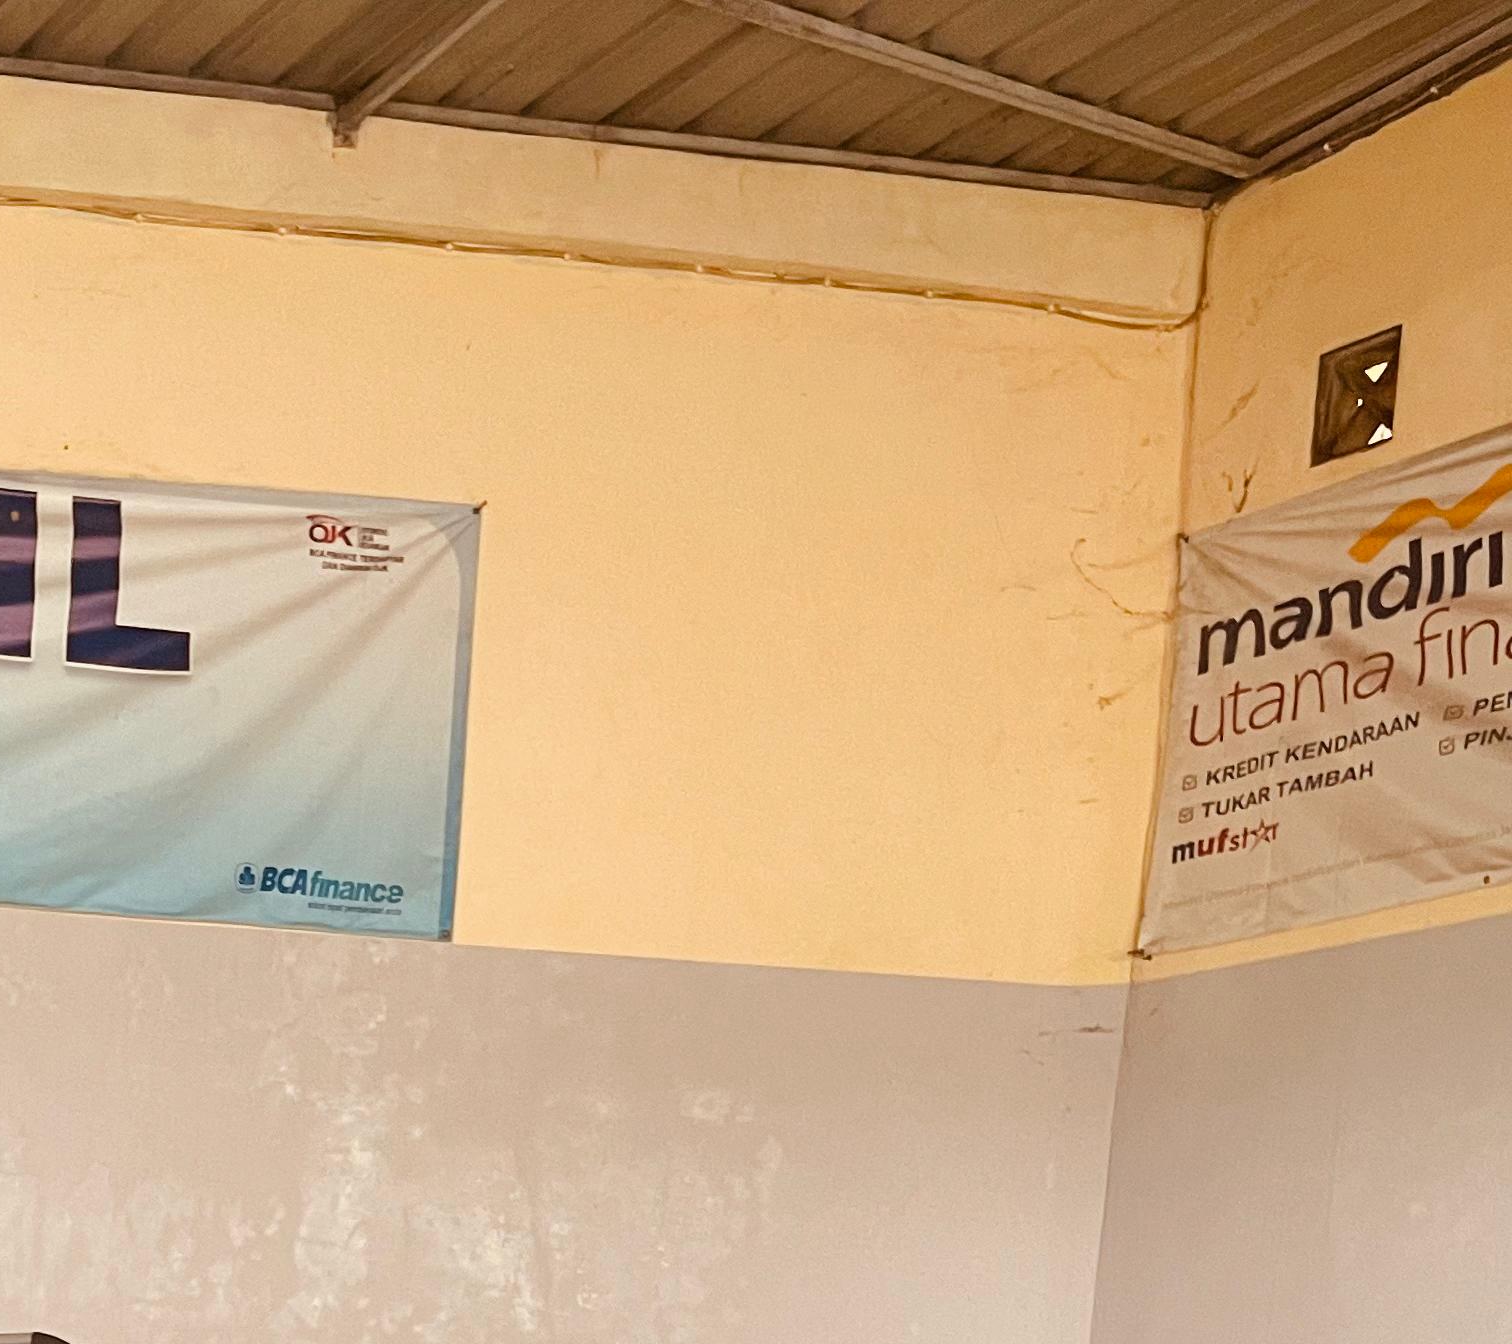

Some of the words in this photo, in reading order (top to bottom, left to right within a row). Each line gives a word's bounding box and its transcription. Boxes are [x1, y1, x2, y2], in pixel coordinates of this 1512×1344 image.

[1196, 530, 1504, 676] mandiri
[1188, 650, 1394, 748] utama
[1413, 606, 1512, 686] fin
[1205, 750, 1278, 786] KREDIT
[1284, 711, 1420, 764] KENDARAAN
[1464, 727, 1512, 749] PIN
[1201, 785, 1271, 818] TUKAR
[1276, 760, 1374, 800] TAMBAH
